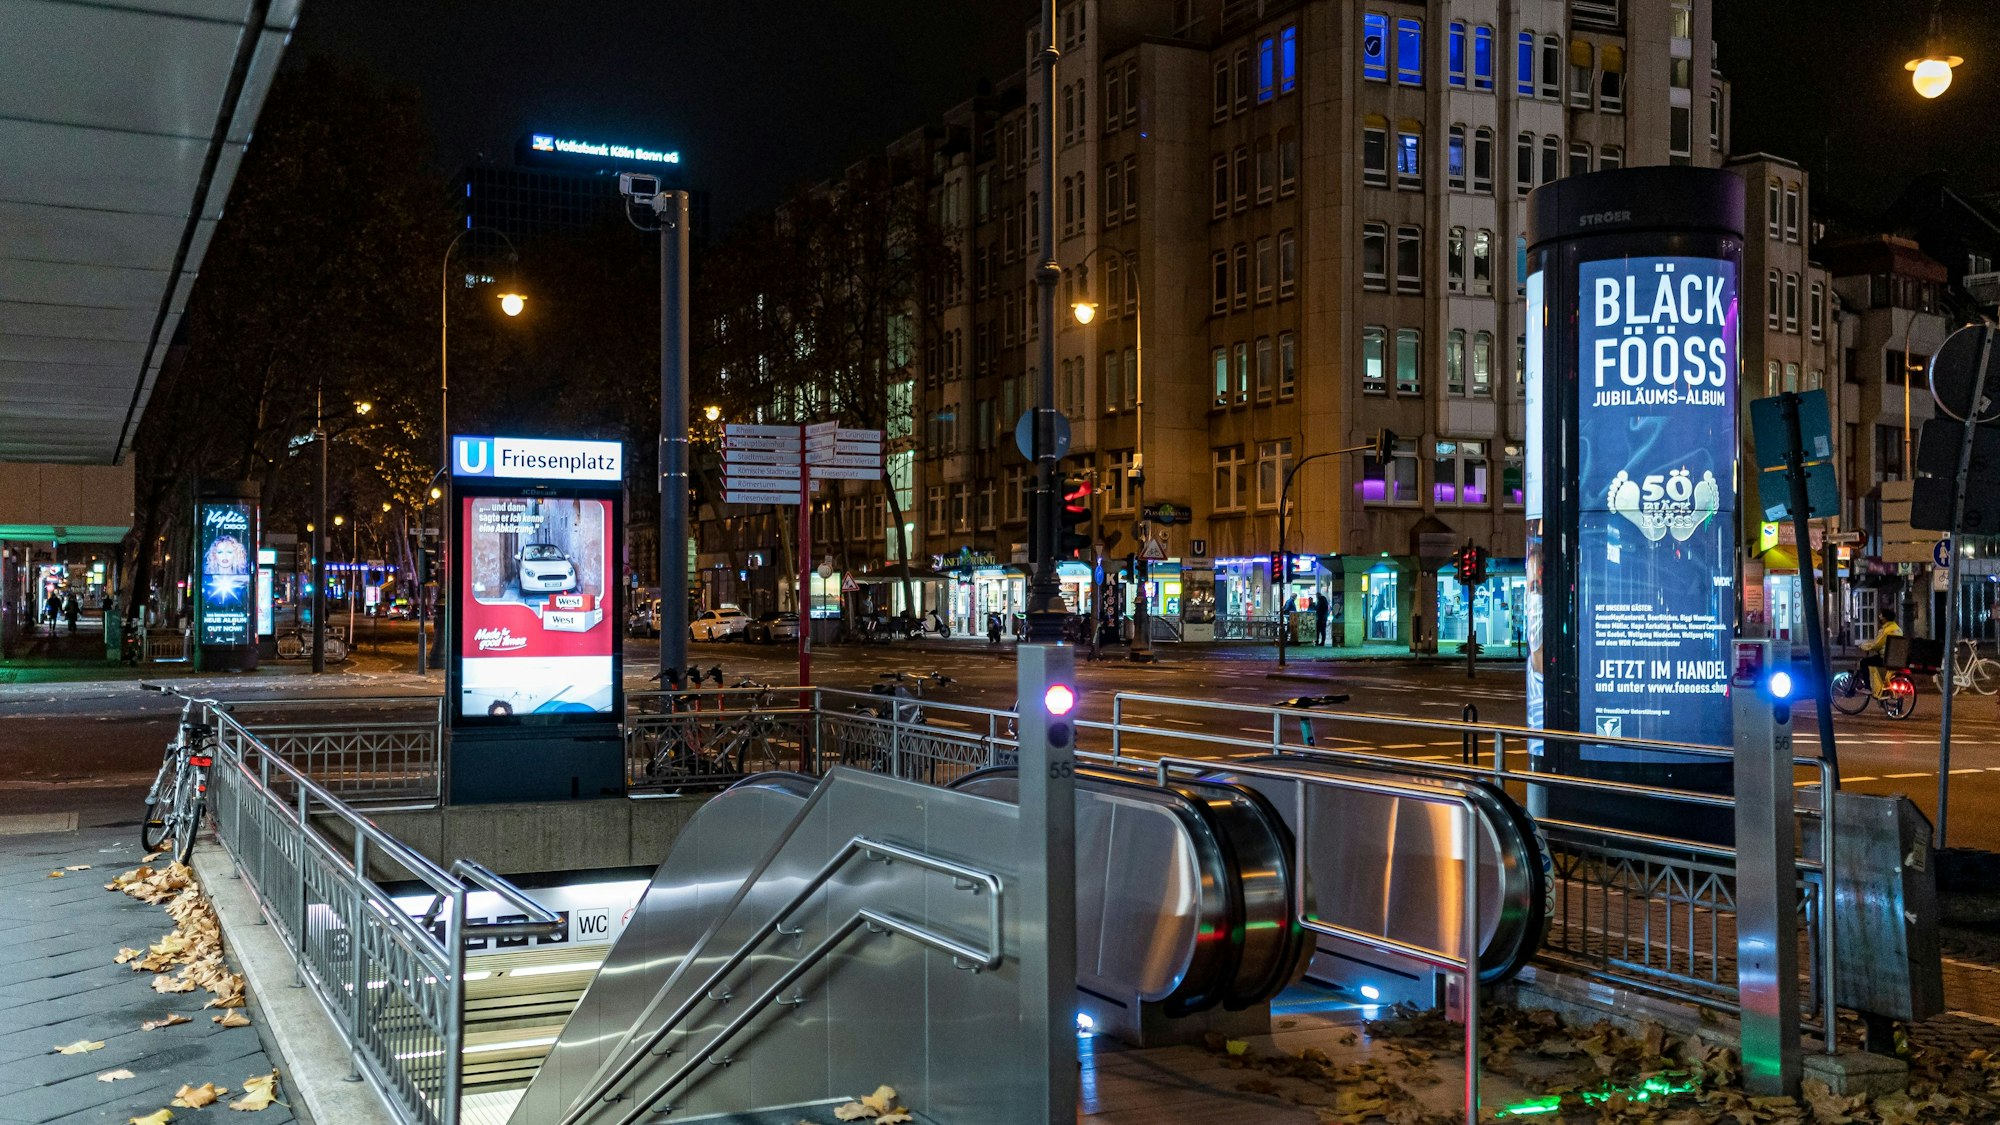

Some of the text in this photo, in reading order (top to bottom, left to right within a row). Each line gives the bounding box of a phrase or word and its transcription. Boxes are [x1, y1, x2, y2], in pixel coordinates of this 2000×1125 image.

[555, 139, 679, 163] Volksbank Köln Bonn eG
[1579, 210, 1631, 227] STRÖER
[1595, 263, 1726, 327] BLÄCK
[1595, 325, 1727, 388] FÖÖSS
[1592, 387, 1726, 407] JUBILÄUMS-ALBUM
[738, 439, 785, 449] Hauptbahnhof
[502, 449, 615, 474] Friesenplatz
[738, 453, 784, 463] Stadtmuseum
[738, 466, 766, 476] Römische
[738, 480, 776, 490] Römerturm
[738, 493, 782, 503] Friesenviertel
[491, 503, 507, 512] und
[507, 503, 526, 512] dann
[206, 510, 246, 529] Kylie
[479, 513, 545, 524] sagte er Ich kenne
[479, 523, 495, 532] eine
[558, 598, 580, 606] West
[1793, 579, 1801, 622] COPY
[552, 615, 574, 624] West
[1595, 659, 1727, 679] JETZT IM HANDEL
[1595, 680, 1728, 696] und unter www.foeoess.shop
[1775, 736, 1789, 750] 56
[579, 914, 607, 934] WC
